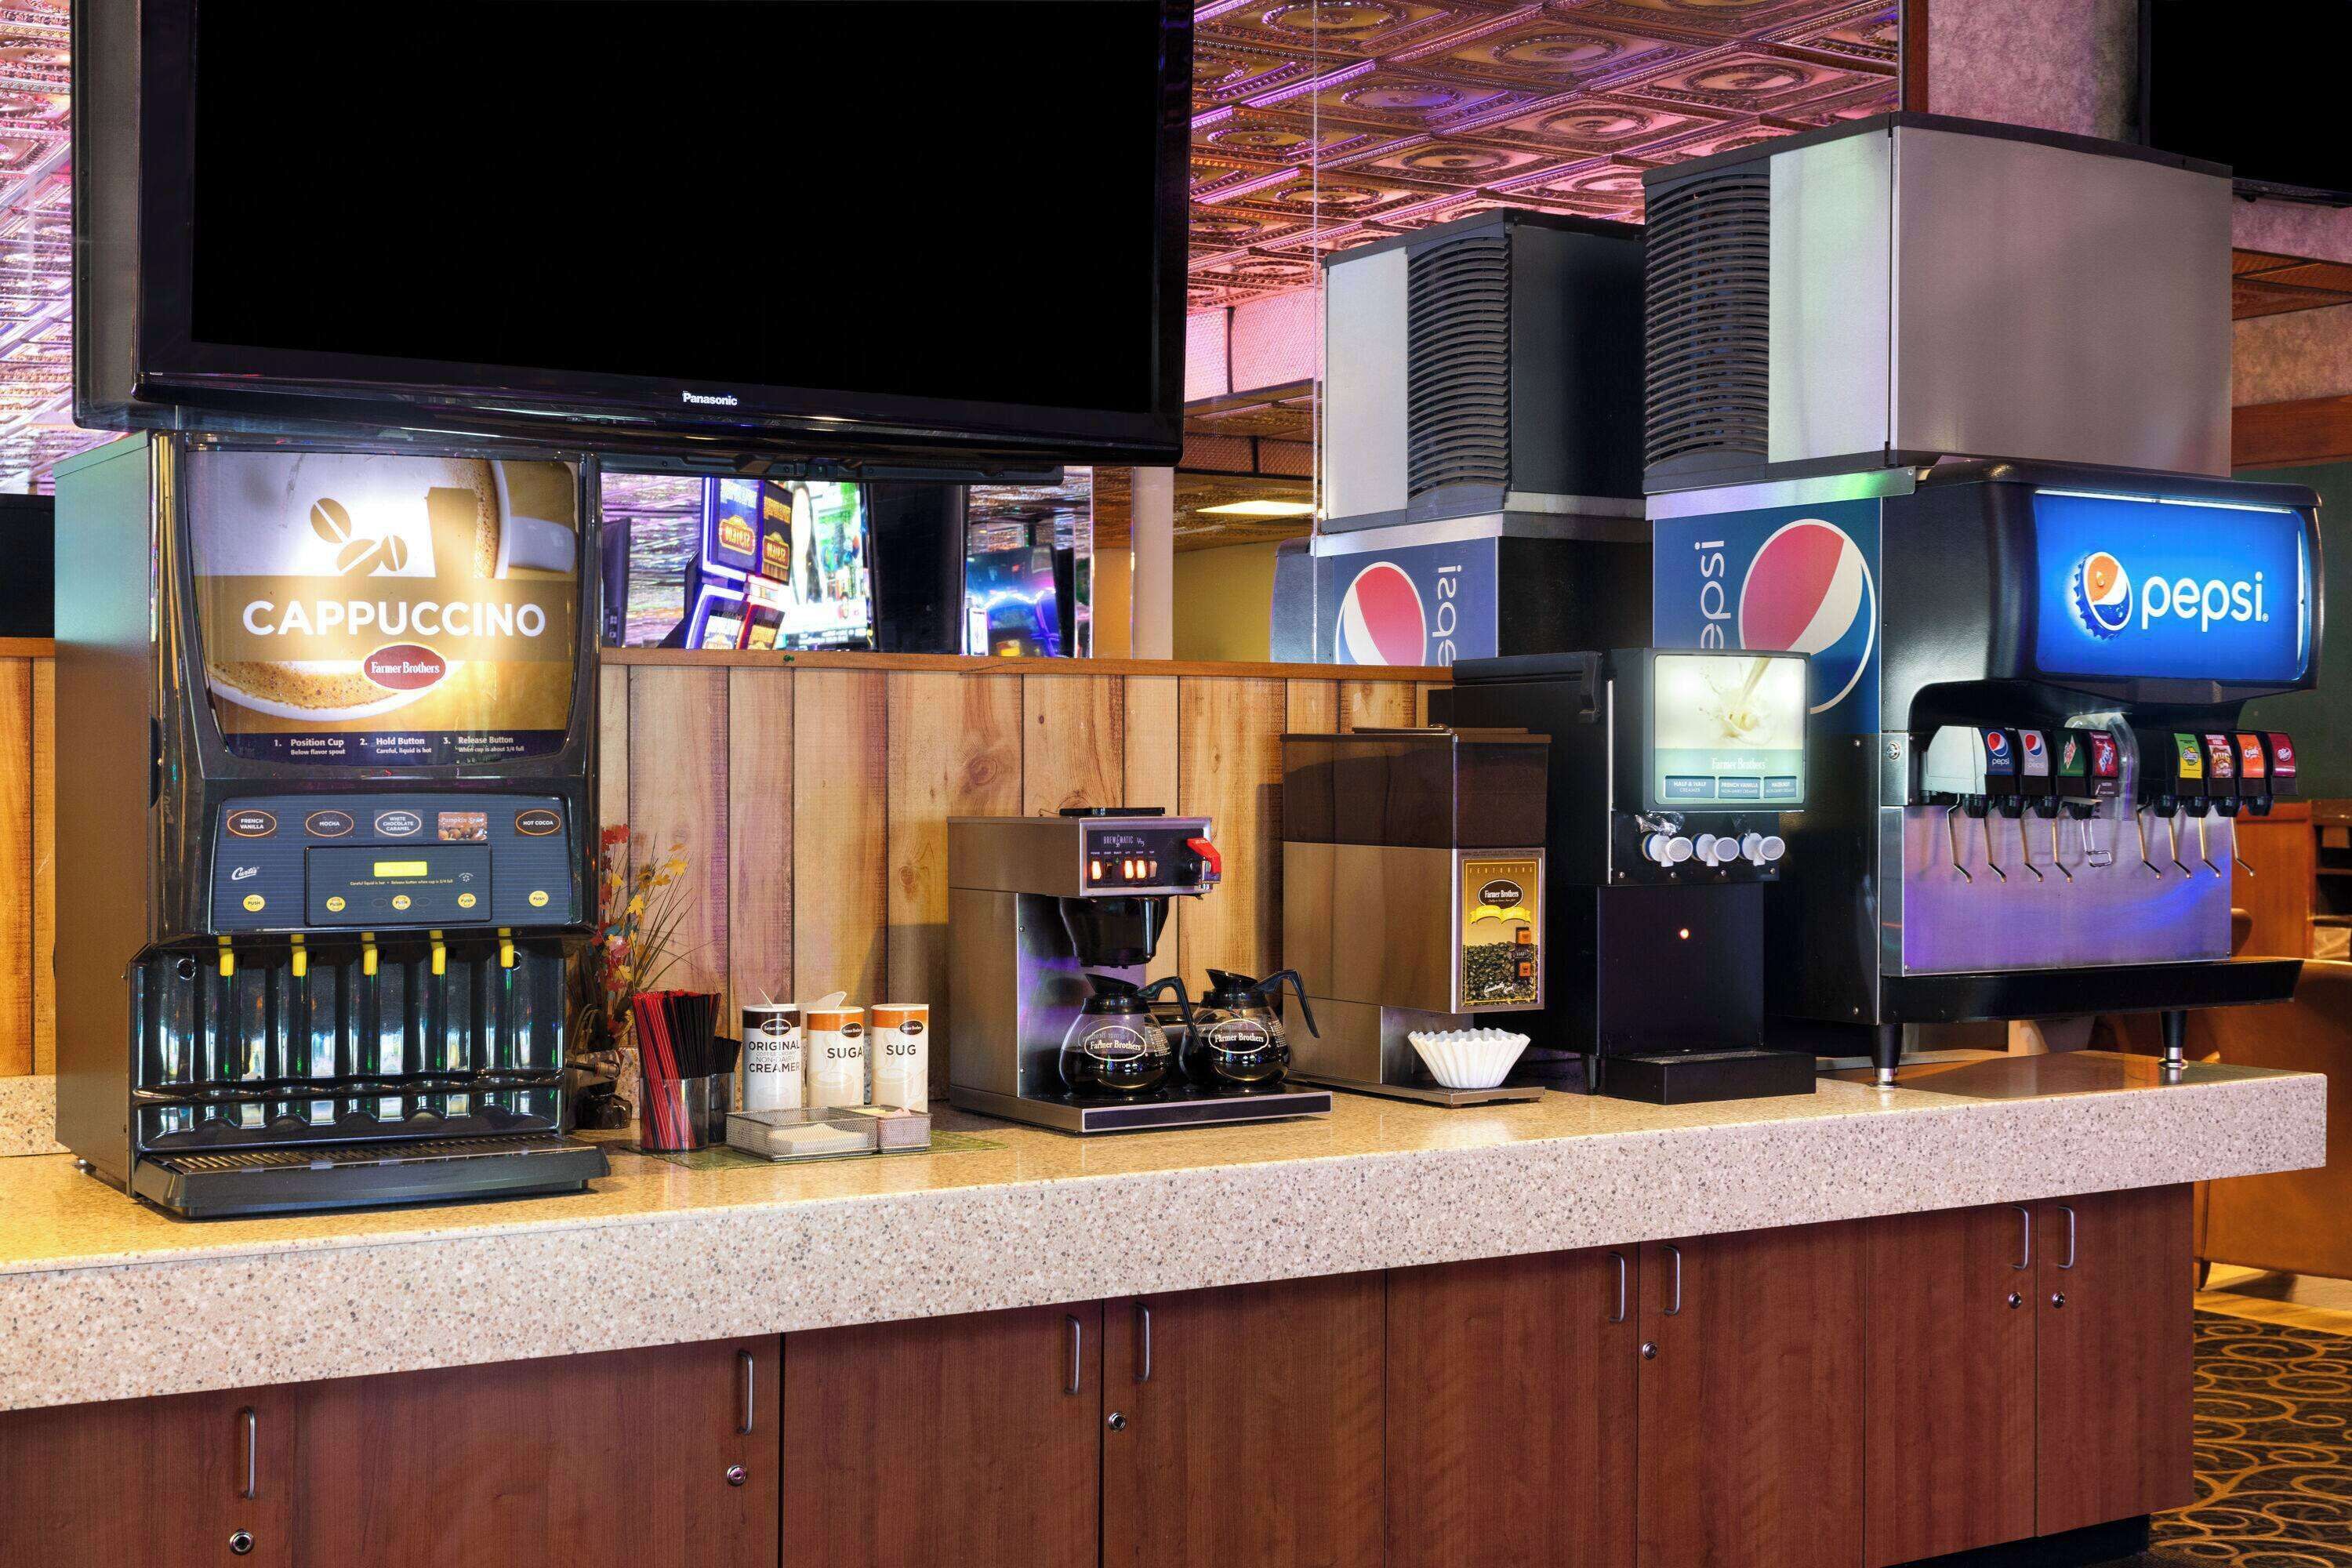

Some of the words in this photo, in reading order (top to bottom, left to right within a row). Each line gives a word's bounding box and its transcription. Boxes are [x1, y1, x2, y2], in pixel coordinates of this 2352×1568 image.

[682, 390, 738, 405] Panasonic
[1694, 541, 1731, 648] epsi
[2141, 571, 2263, 632] pepsi
[242, 601, 546, 637] CAPPUCCINO
[371, 661, 401, 673] Farmer
[403, 660, 440, 673] Brothers
[328, 738, 344, 747] Cup
[1711, 758, 1736, 770] Farmer
[1737, 757, 1765, 770] Brothers
[231, 866, 257, 880] Curtis
[1484, 890, 1501, 898] Farmer
[1501, 889, 1519, 898] Brothers
[1214, 1033, 1237, 1043] Farmer
[1239, 1033, 1264, 1043] Brothers
[749, 1041, 800, 1051] ORIGINAL
[886, 1044, 916, 1055] SUG
[1090, 1040, 1112, 1050] Farmer
[1114, 1040, 1141, 1051] Brothers
[749, 1063, 800, 1073] CREAMER
